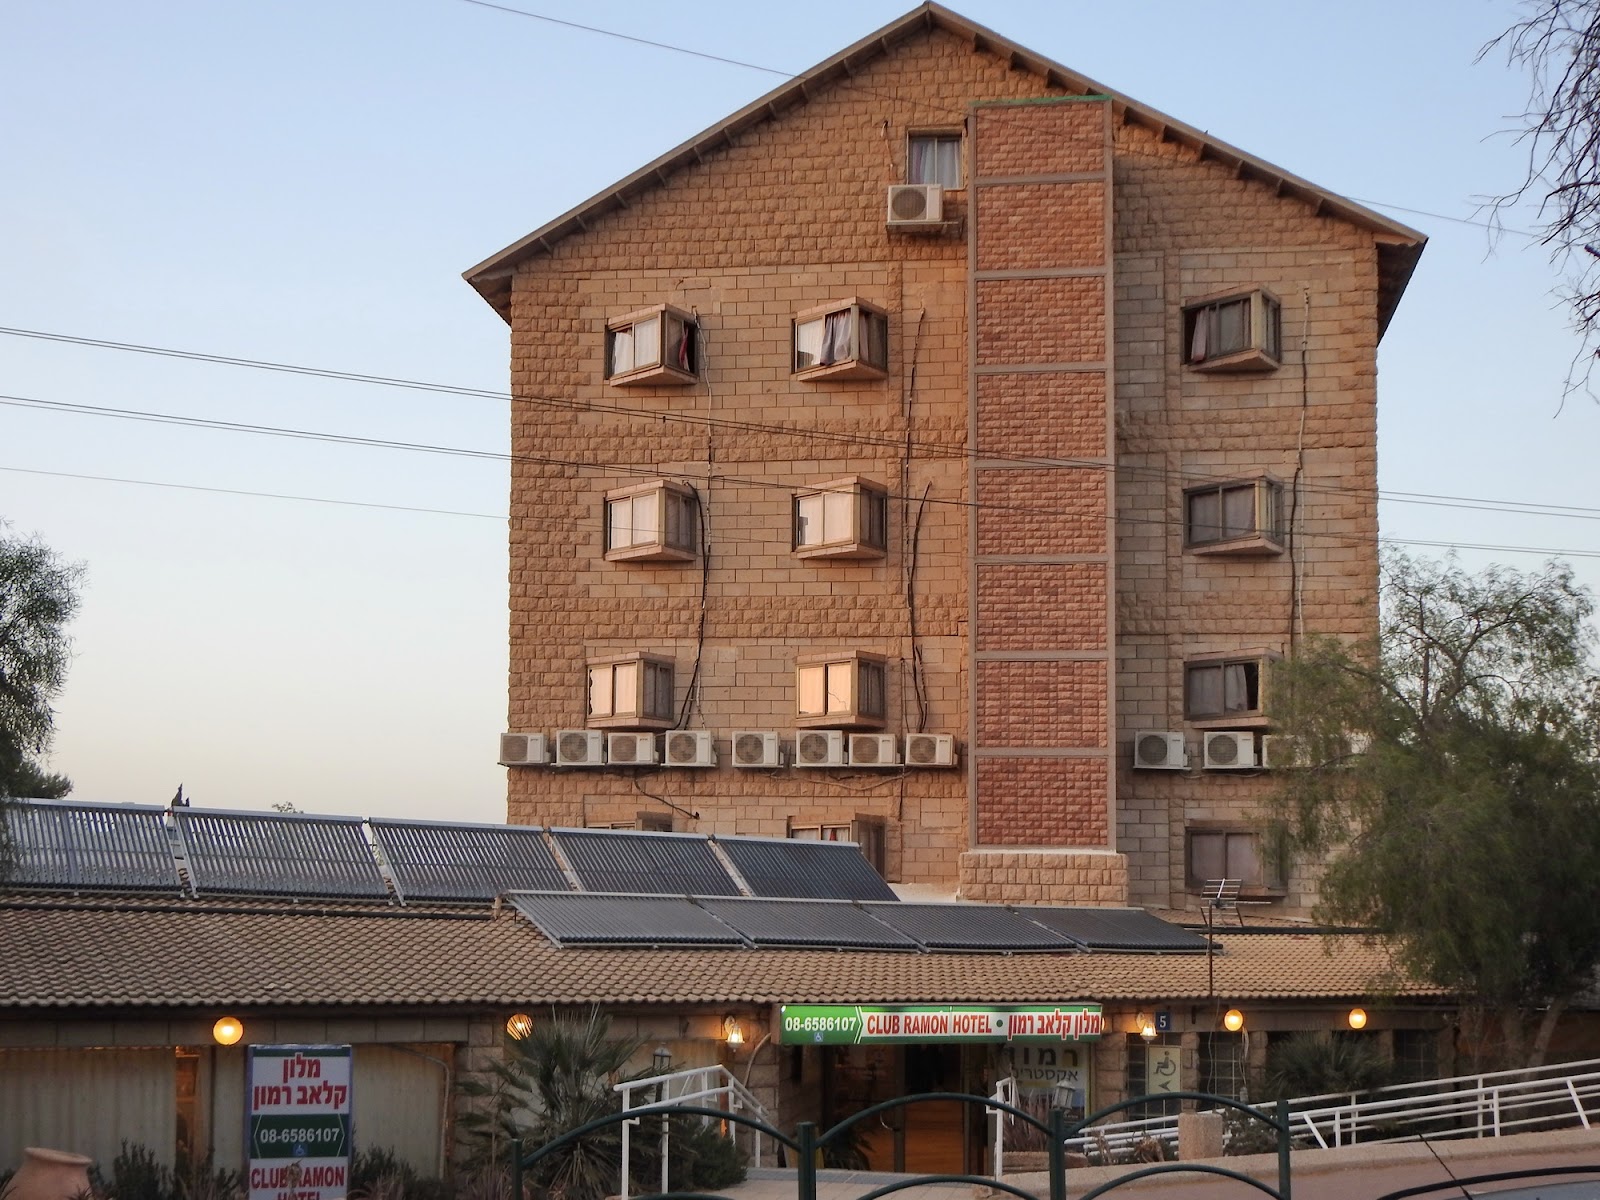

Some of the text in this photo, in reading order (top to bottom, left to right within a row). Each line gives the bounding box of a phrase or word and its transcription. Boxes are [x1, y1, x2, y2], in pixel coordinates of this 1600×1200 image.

[785, 1016, 857, 1032] 08-6586107
[867, 1014, 992, 1035] CLUB RAMON HOTEL
[1007, 1009, 1101, 1040] מלון קלאב רמון
[1159, 1015, 1167, 1028] 5
[282, 1053, 321, 1083] מלון
[254, 1080, 347, 1110] קלאב רמון
[260, 1128, 340, 1144] 08-6586107
[251, 1165, 345, 1189] CLUB AMON
